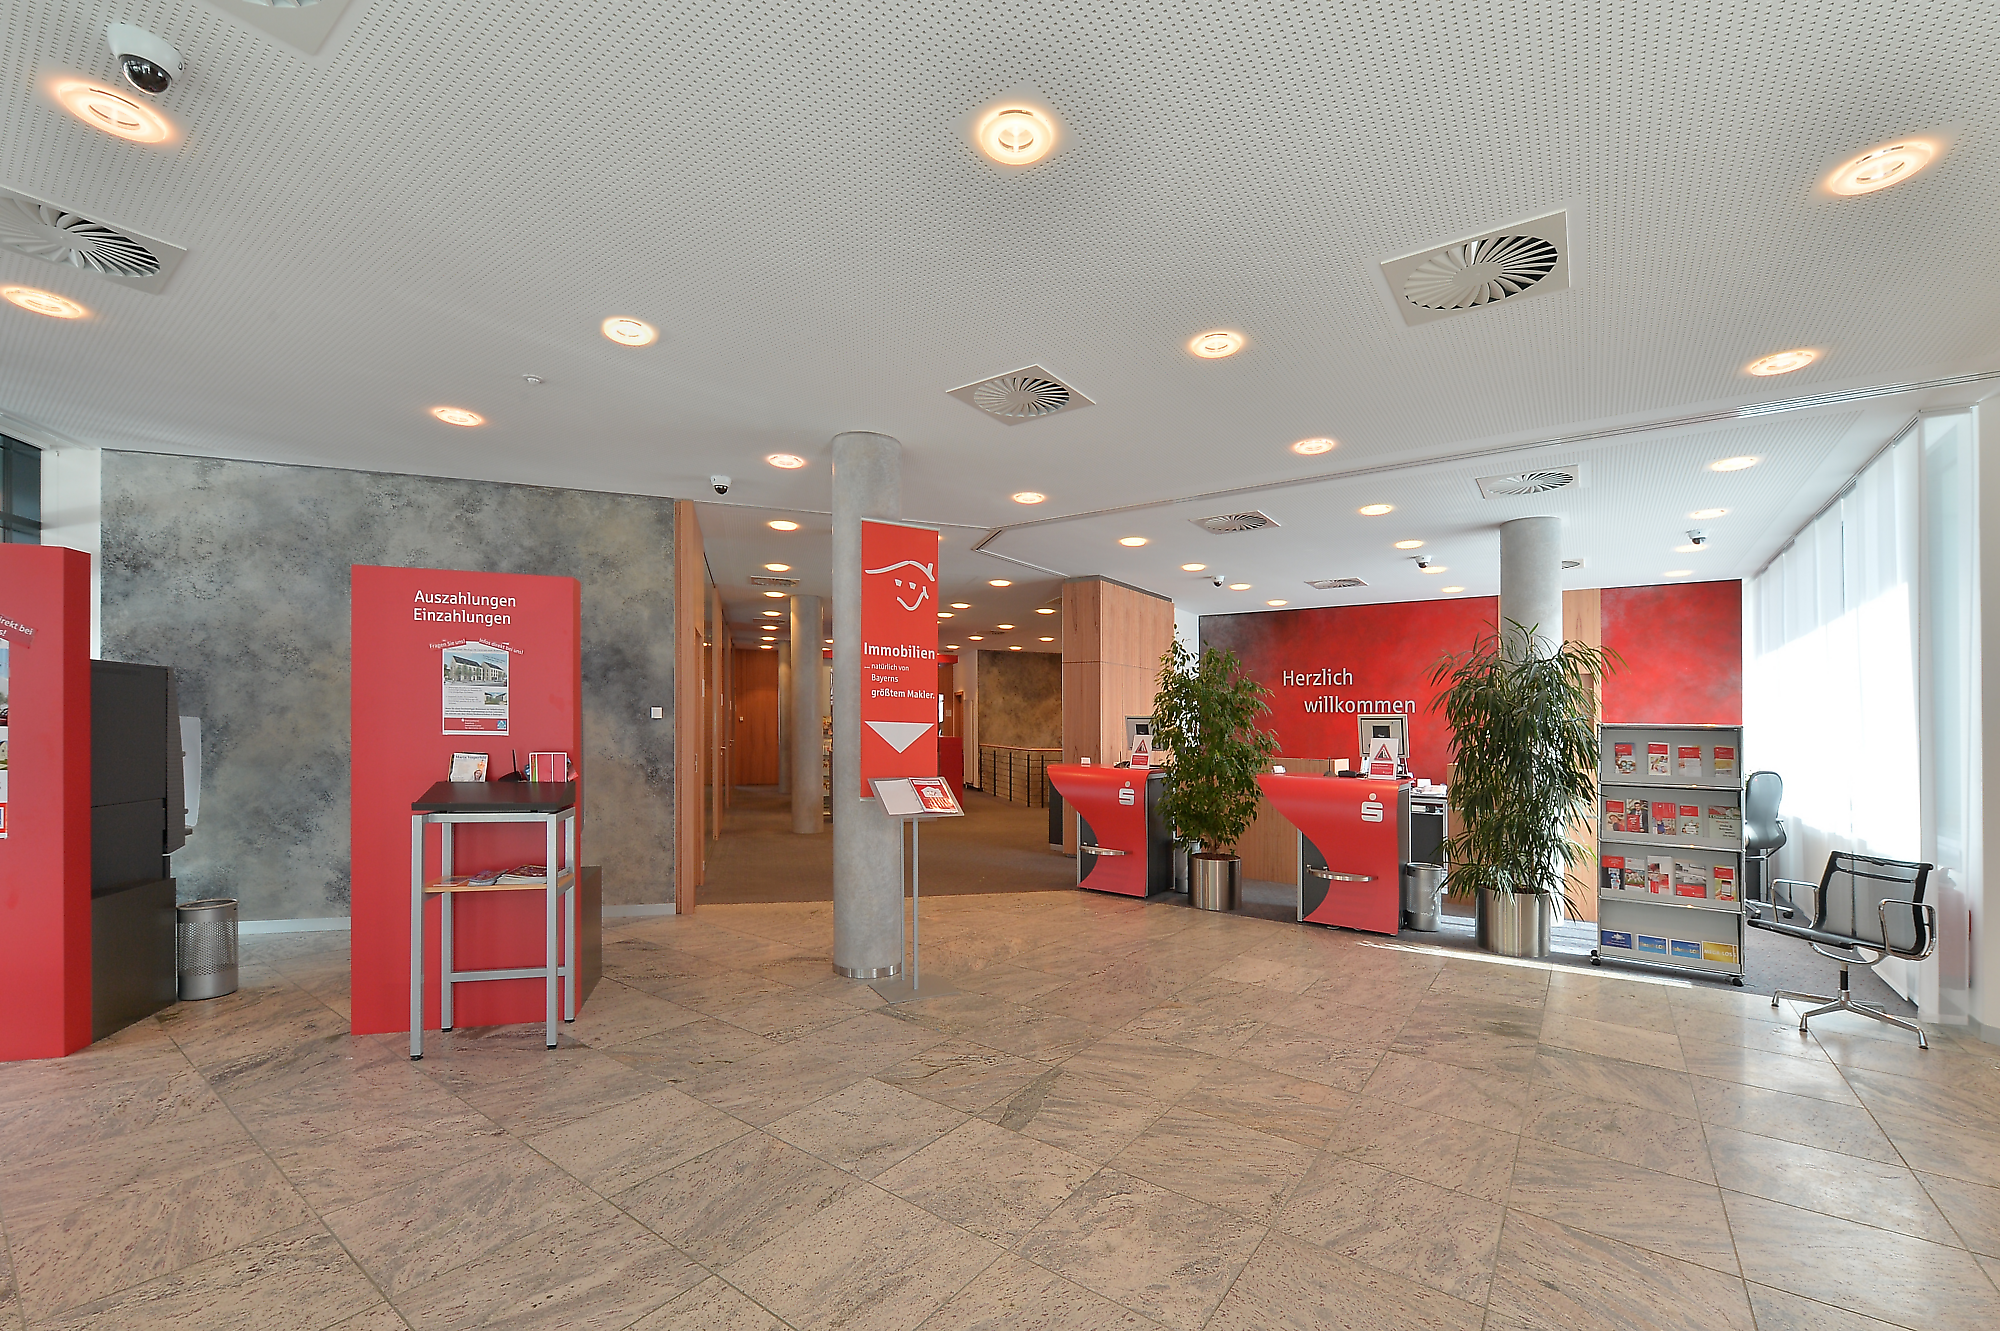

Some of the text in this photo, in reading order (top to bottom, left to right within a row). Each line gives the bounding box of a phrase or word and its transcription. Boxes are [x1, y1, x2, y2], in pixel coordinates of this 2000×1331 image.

[414, 590, 517, 610] Auszahlungen
[413, 607, 511, 627] Einzahlungen
[19, 624, 34, 636] bei
[429, 641, 447, 649] Fragen
[479, 637, 491, 646] Infos
[491, 641, 505, 650] direkt
[864, 642, 935, 660] Immobilien
[871, 663, 898, 671] natürlich
[871, 673, 899, 684] Bayerns
[1283, 667, 1353, 687] Herzlich
[871, 688, 935, 699] größtem Makler.
[1304, 695, 1416, 713] willkommen
